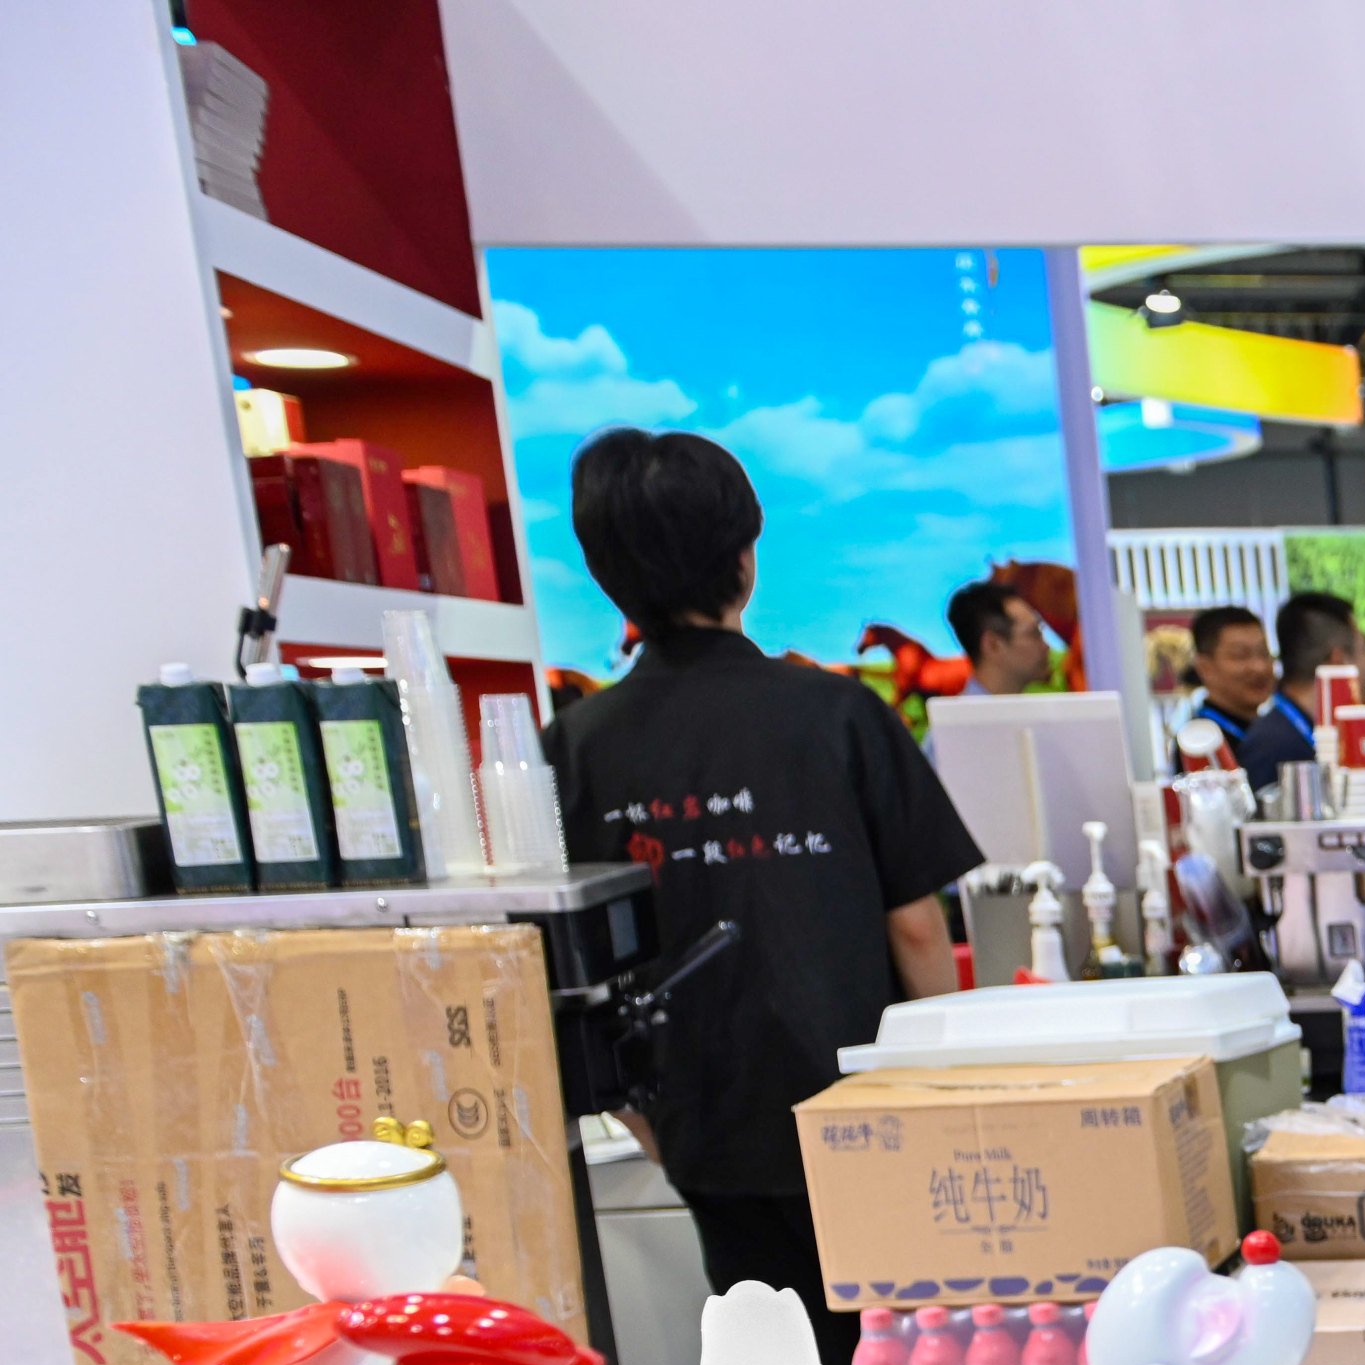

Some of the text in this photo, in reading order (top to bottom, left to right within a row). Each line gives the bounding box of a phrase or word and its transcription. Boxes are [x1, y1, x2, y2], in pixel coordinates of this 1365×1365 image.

[445, 1005, 471, 1048] SGS
[1080, 1106, 1142, 1129] 周转箱
[953, 1148, 1013, 1163] Pure Milk
[928, 1165, 1050, 1224] 纯牛奶
[45, 1199, 107, 1365] 太空舱
